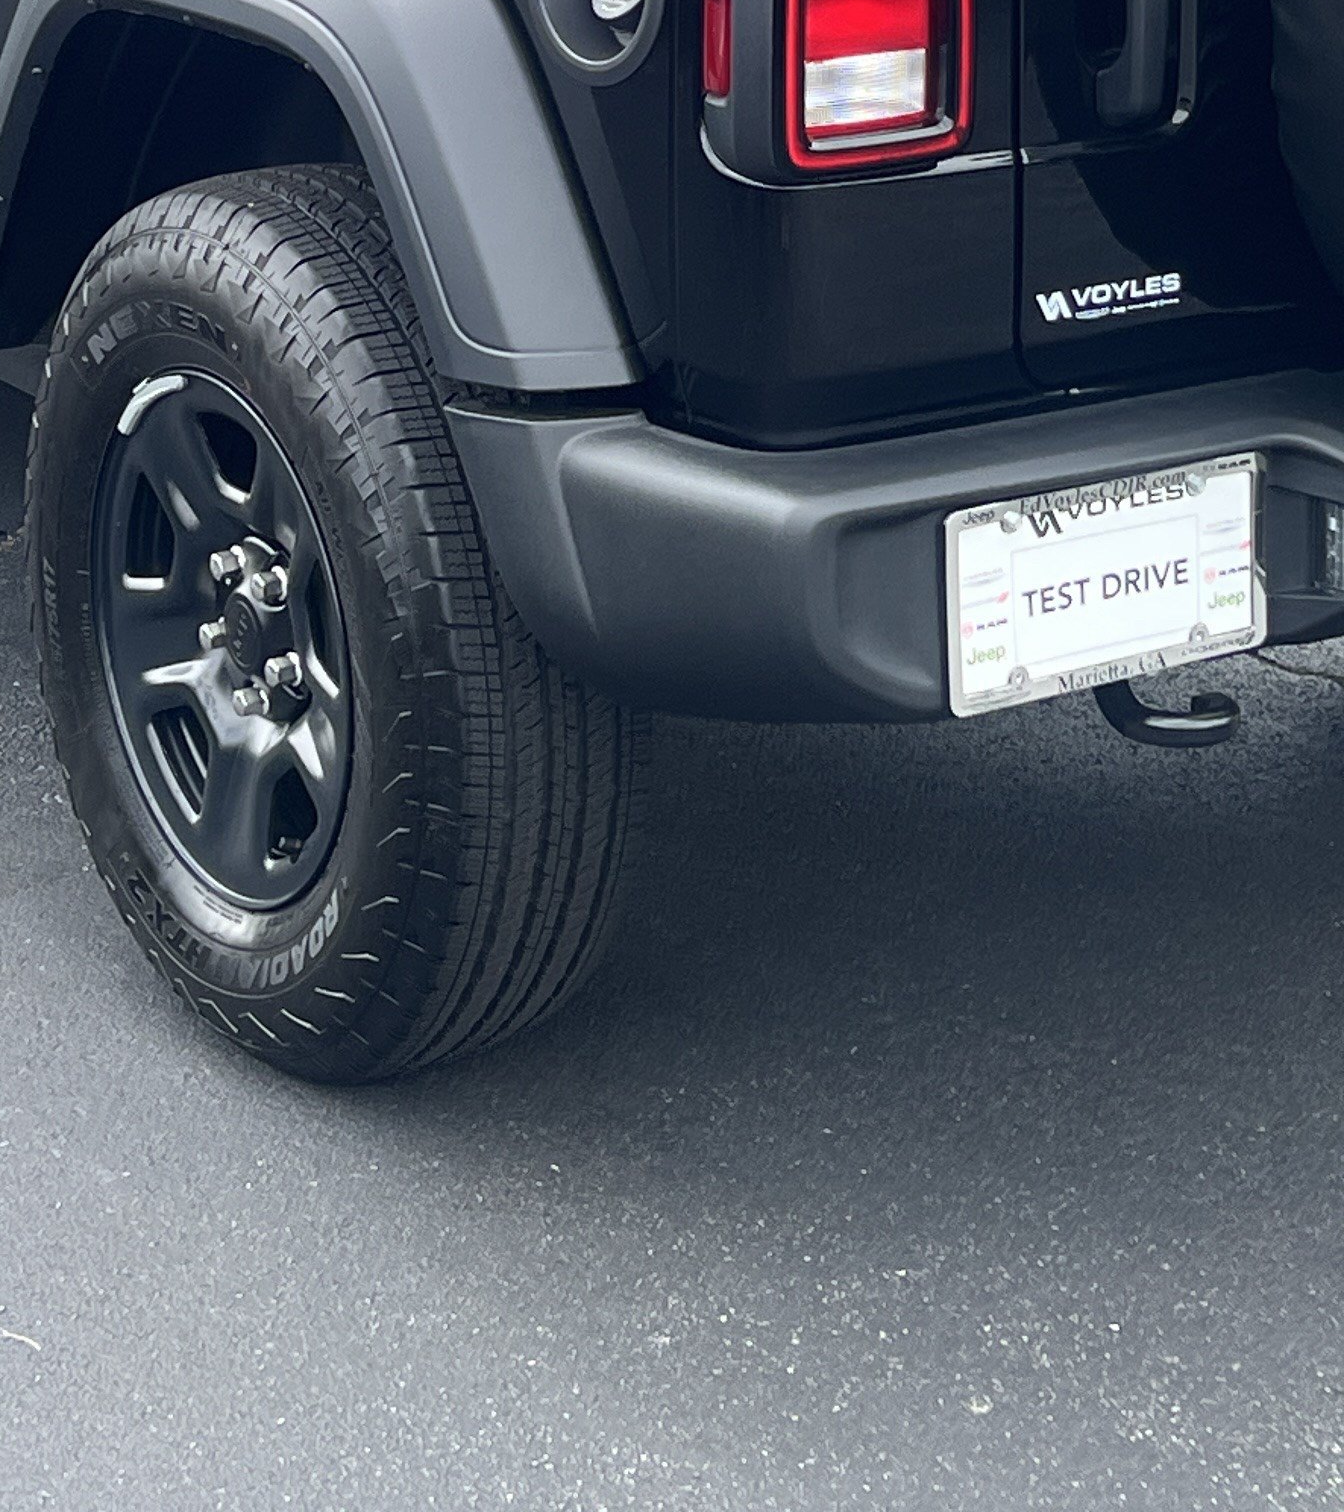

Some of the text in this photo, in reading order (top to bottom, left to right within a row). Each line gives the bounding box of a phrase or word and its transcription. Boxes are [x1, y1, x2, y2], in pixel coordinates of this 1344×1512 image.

[1071, 272, 1181, 306] VOYLES
[86, 299, 228, 365] NEXEN
[962, 509, 996, 526] Jeep
[1067, 484, 1184, 519] VOYLES
[1022, 557, 1190, 618] TEST DRIVE
[1207, 590, 1246, 609] Jeep
[966, 644, 1006, 665] Jeep
[1057, 662, 1135, 693] Marietta,
